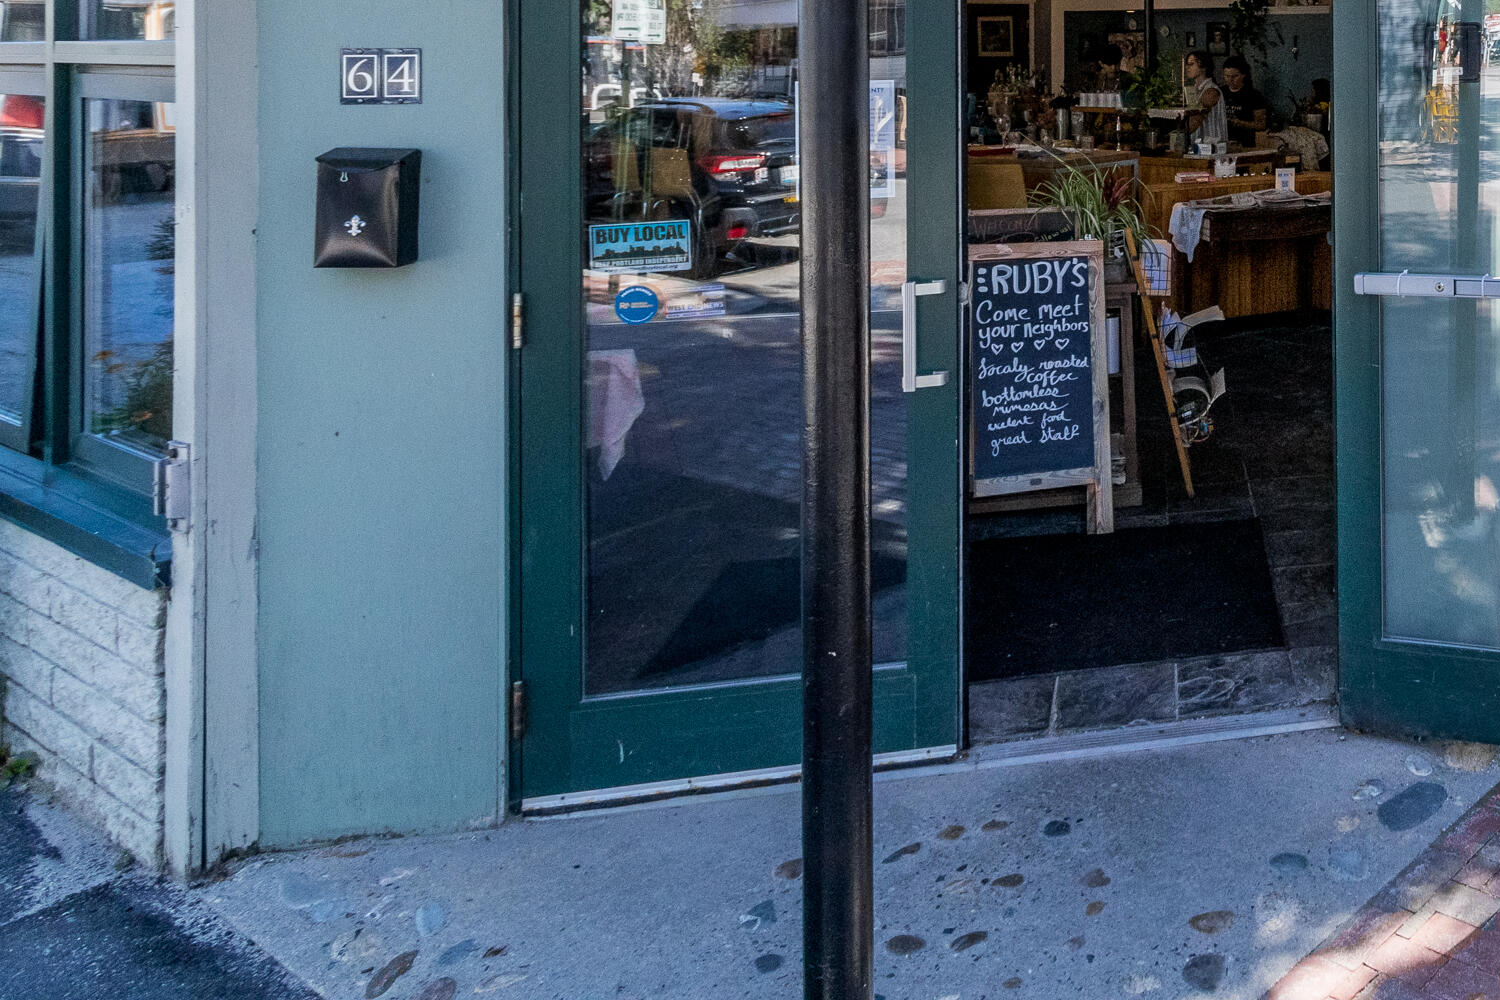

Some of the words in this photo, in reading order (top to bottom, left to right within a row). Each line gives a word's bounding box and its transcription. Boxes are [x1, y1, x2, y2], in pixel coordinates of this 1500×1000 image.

[347, 58, 415, 92] 64
[595, 227, 629, 244] BUY
[634, 224, 686, 242] LOCAL
[976, 300, 1030, 324] Come
[978, 323, 1021, 348] your
[1023, 318, 1089, 340] neighbors
[1039, 354, 1089, 370] roasted
[1026, 370, 1078, 387] coffee
[982, 384, 1070, 407] bottomless
[1040, 410, 1071, 428] food
[991, 431, 1032, 456] great
